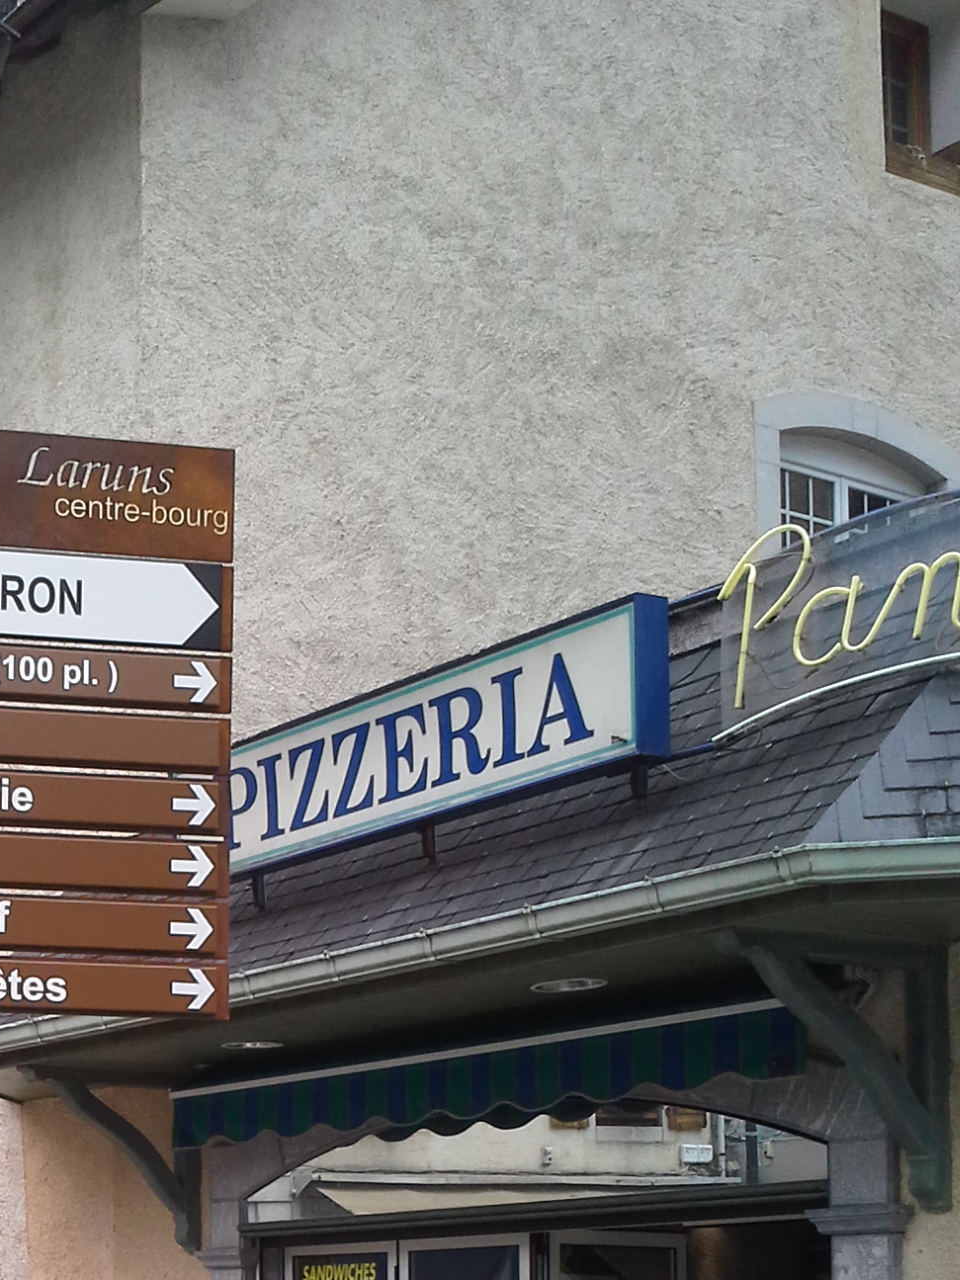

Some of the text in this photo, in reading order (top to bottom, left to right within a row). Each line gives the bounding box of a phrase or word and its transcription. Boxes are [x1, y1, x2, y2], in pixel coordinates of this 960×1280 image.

[16, 446, 175, 496] Laruns
[54, 496, 230, 536] centre-bourg
[62, 657, 100, 689] pl.
[228, 651, 594, 851] PIZZERIA
